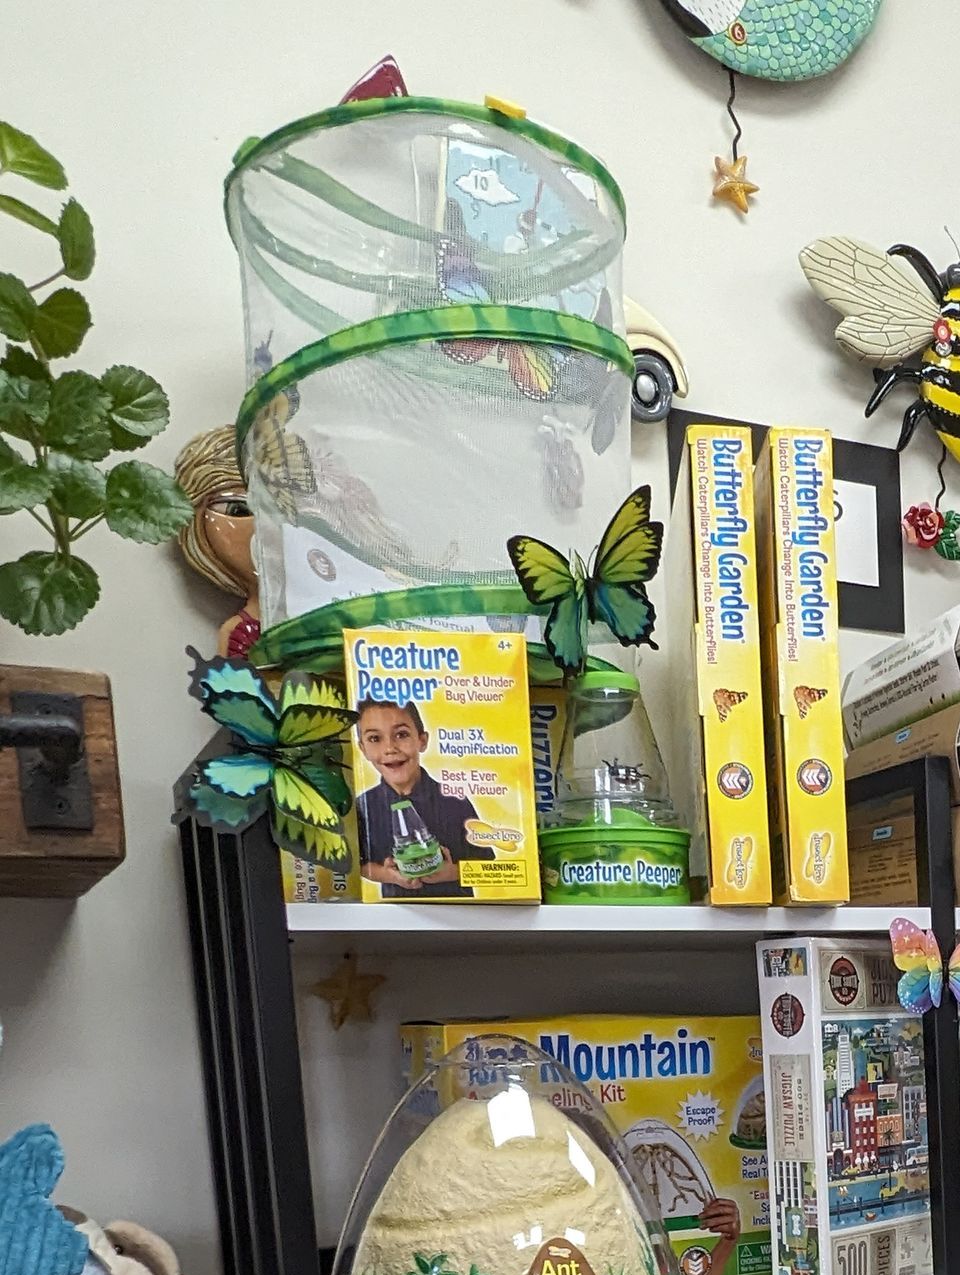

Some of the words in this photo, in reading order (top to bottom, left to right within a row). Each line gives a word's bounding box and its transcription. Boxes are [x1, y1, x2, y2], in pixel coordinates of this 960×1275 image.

[697, 438, 707, 473] Watch
[778, 438, 789, 472] Watch
[698, 476, 709, 537] Caterpillars
[711, 439, 748, 547] Butterfly
[779, 475, 790, 535] Caterpillars
[793, 438, 828, 545] Butterfly
[700, 540, 711, 578] Change
[782, 539, 793, 577] Change
[703, 582, 712, 603] Into
[718, 553, 749, 641] Garden
[785, 580, 793, 601] Into
[799, 552, 829, 639] Garden
[705, 606, 718, 664] Butterflies!
[785, 604, 798, 662] Butterflies!
[354, 639, 460, 670] Creature
[358, 671, 438, 706] Peeper
[445, 676, 471, 687] Over
[473, 676, 481, 687] &
[483, 677, 514, 688] Under
[445, 691, 466, 704] Bug
[467, 691, 504, 702] Viewer
[438, 729, 465, 741] Dual
[469, 729, 485, 741] 3X
[439, 743, 519, 756] Magnification
[442, 770, 467, 782] Best
[471, 771, 498, 782] Ever
[442, 784, 465, 798] Bug
[469, 785, 508, 796] Viewer
[562, 861, 631, 883] Creature
[638, 861, 681, 887] Peeper
[540, 1029, 711, 1084] Mountain
[600, 1084, 627, 1104] Kit
[781, 1072, 793, 1110] JIGSAW
[686, 1105, 716, 1118] Escape
[688, 1115, 715, 1127] Proof!
[783, 1113, 795, 1146] PUZZLE
